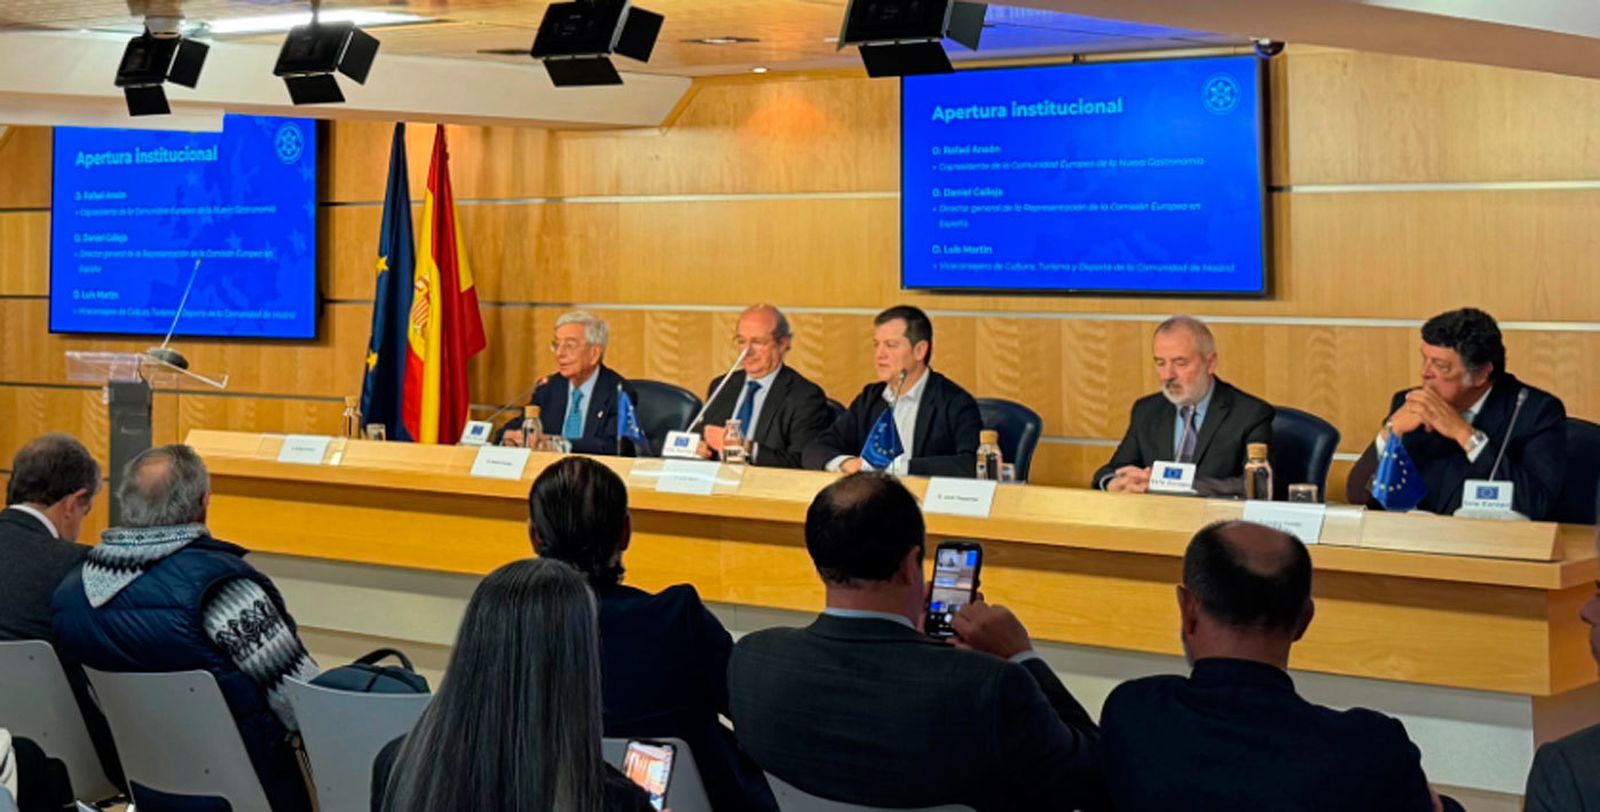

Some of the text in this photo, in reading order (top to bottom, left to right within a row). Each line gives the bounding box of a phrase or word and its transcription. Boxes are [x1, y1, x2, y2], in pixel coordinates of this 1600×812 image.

[931, 97, 1123, 124] Apertura institucional
[75, 145, 218, 169] Apertura institucional
[943, 187, 971, 197] Daniel
[973, 187, 1004, 198] Calleja
[943, 244, 961, 254] Luis
